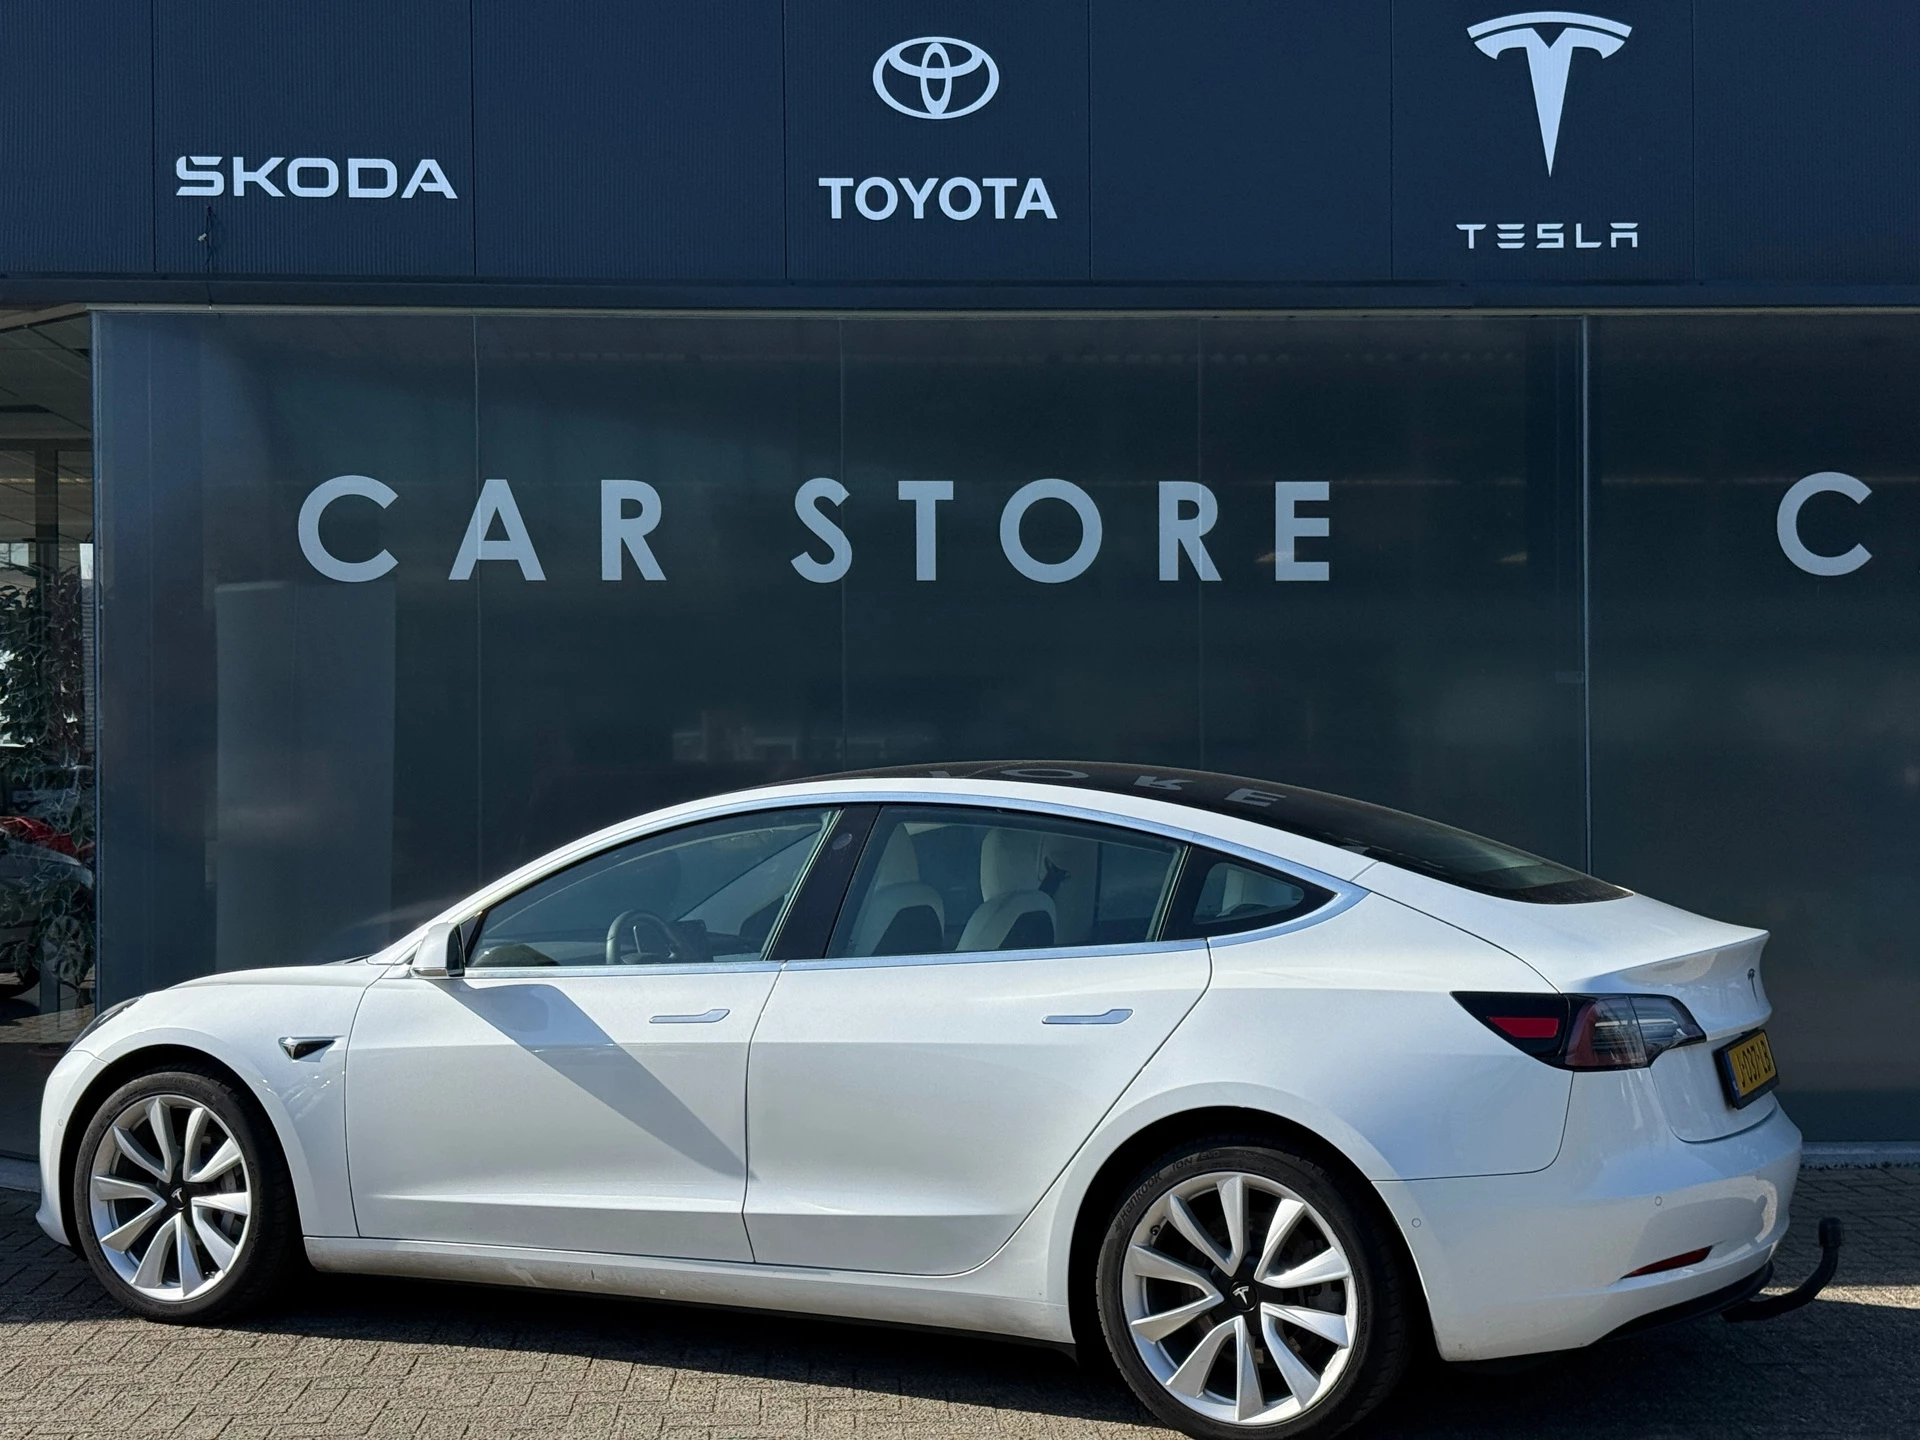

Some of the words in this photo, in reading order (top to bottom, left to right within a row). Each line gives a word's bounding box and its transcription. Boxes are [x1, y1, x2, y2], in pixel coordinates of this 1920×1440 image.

[818, 176, 1058, 221] TOYOTA
[1456, 222, 1639, 249] TESLA
[298, 475, 667, 583] CAR
[790, 477, 1330, 584] STORE
